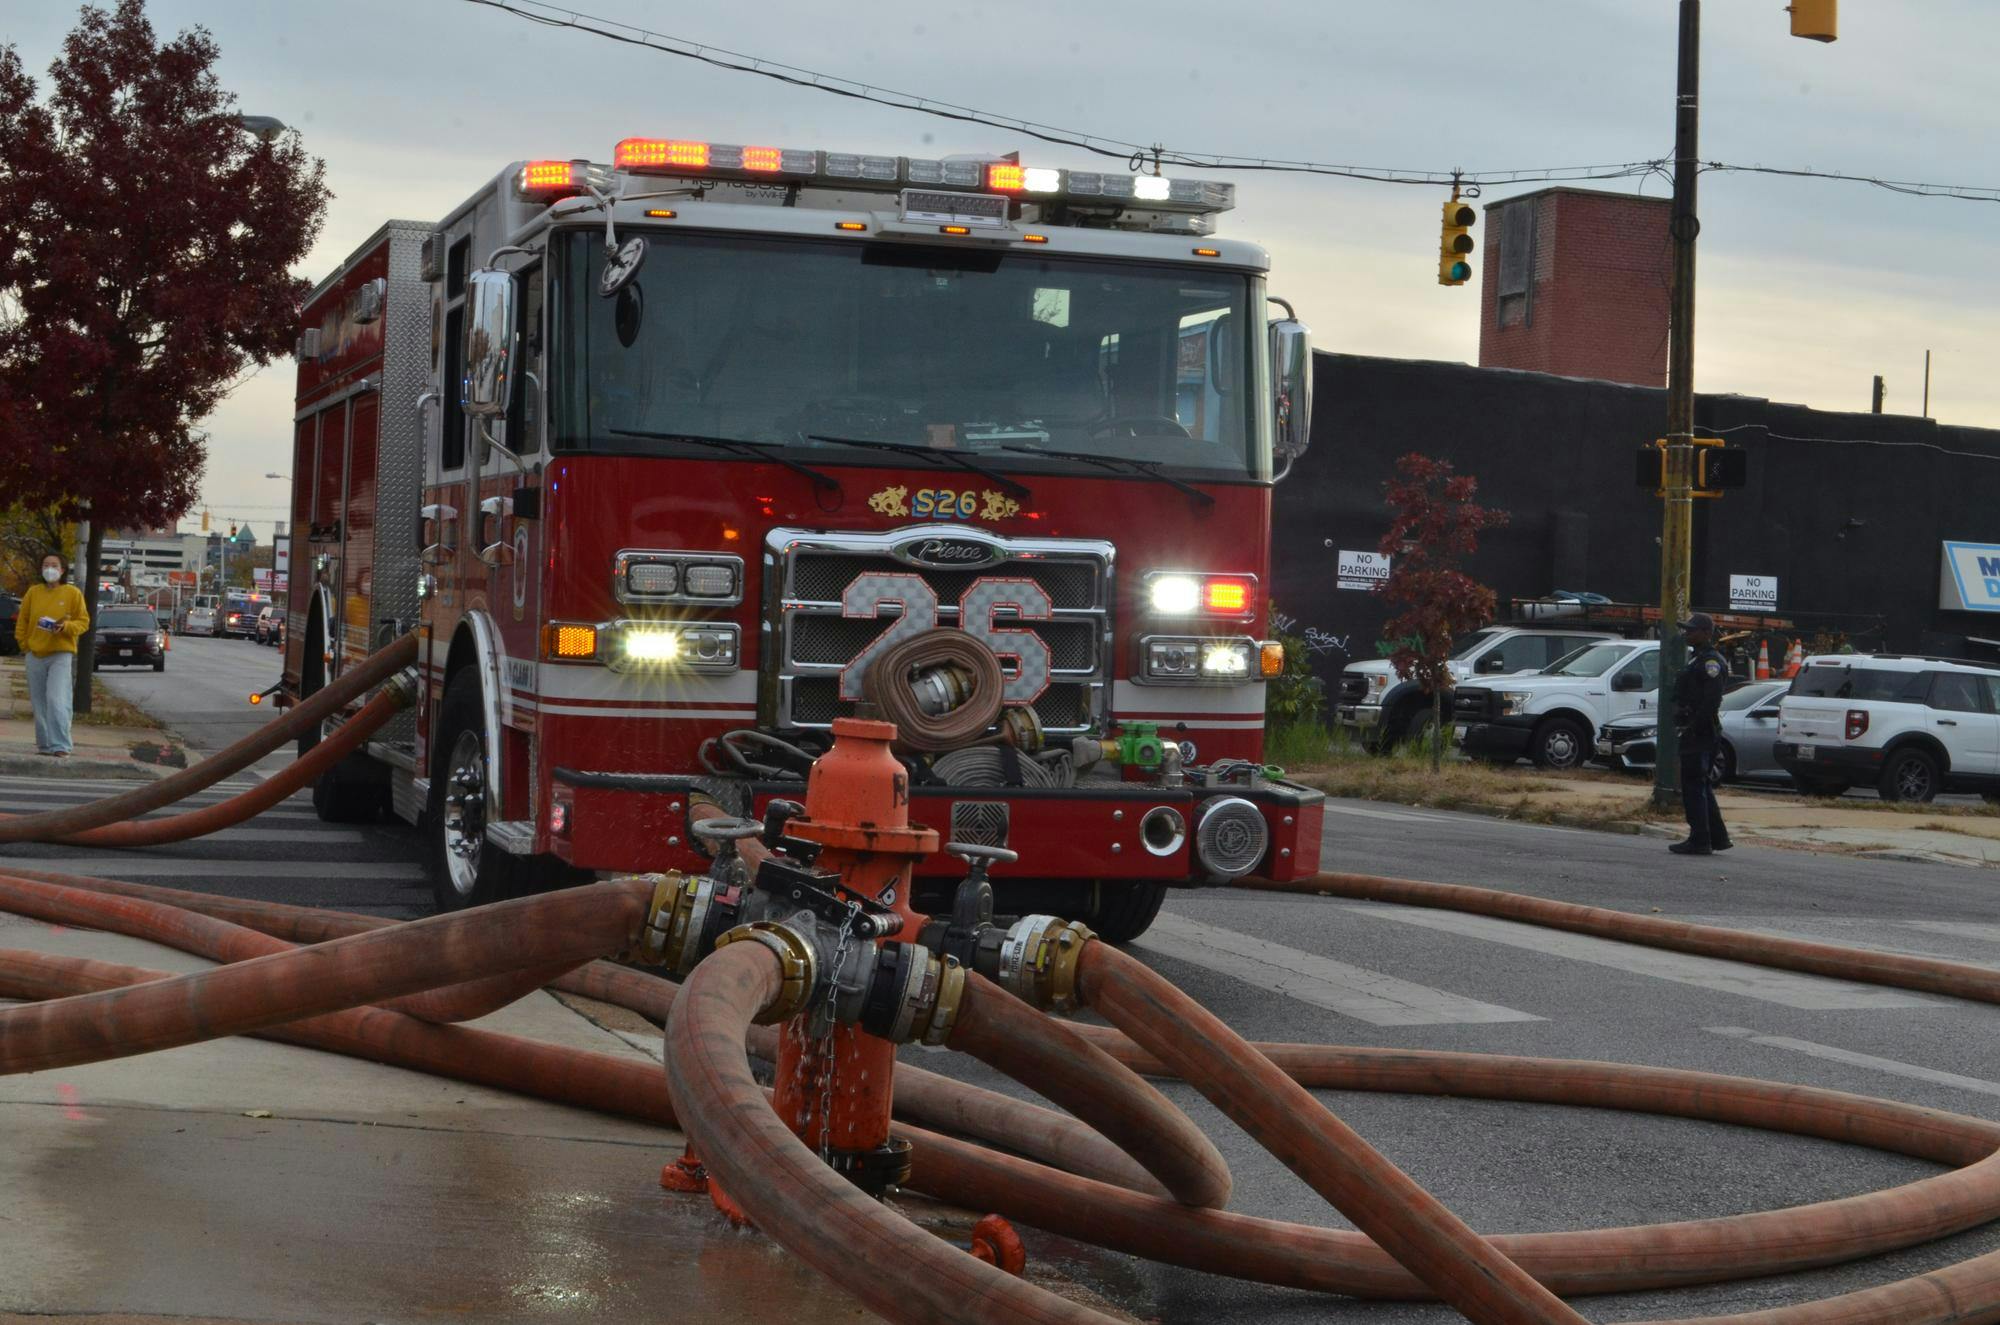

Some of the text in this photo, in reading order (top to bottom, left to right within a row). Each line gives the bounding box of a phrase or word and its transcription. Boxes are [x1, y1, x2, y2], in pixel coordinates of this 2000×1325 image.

[912, 488, 977, 519] S26
[917, 538, 983, 561] Pierce
[1357, 554, 1373, 564] NO
[1340, 565, 1388, 577] PARKING
[1746, 578, 1761, 587] NO
[1731, 588, 1776, 600] PARKING
[839, 571, 1053, 706] 26
